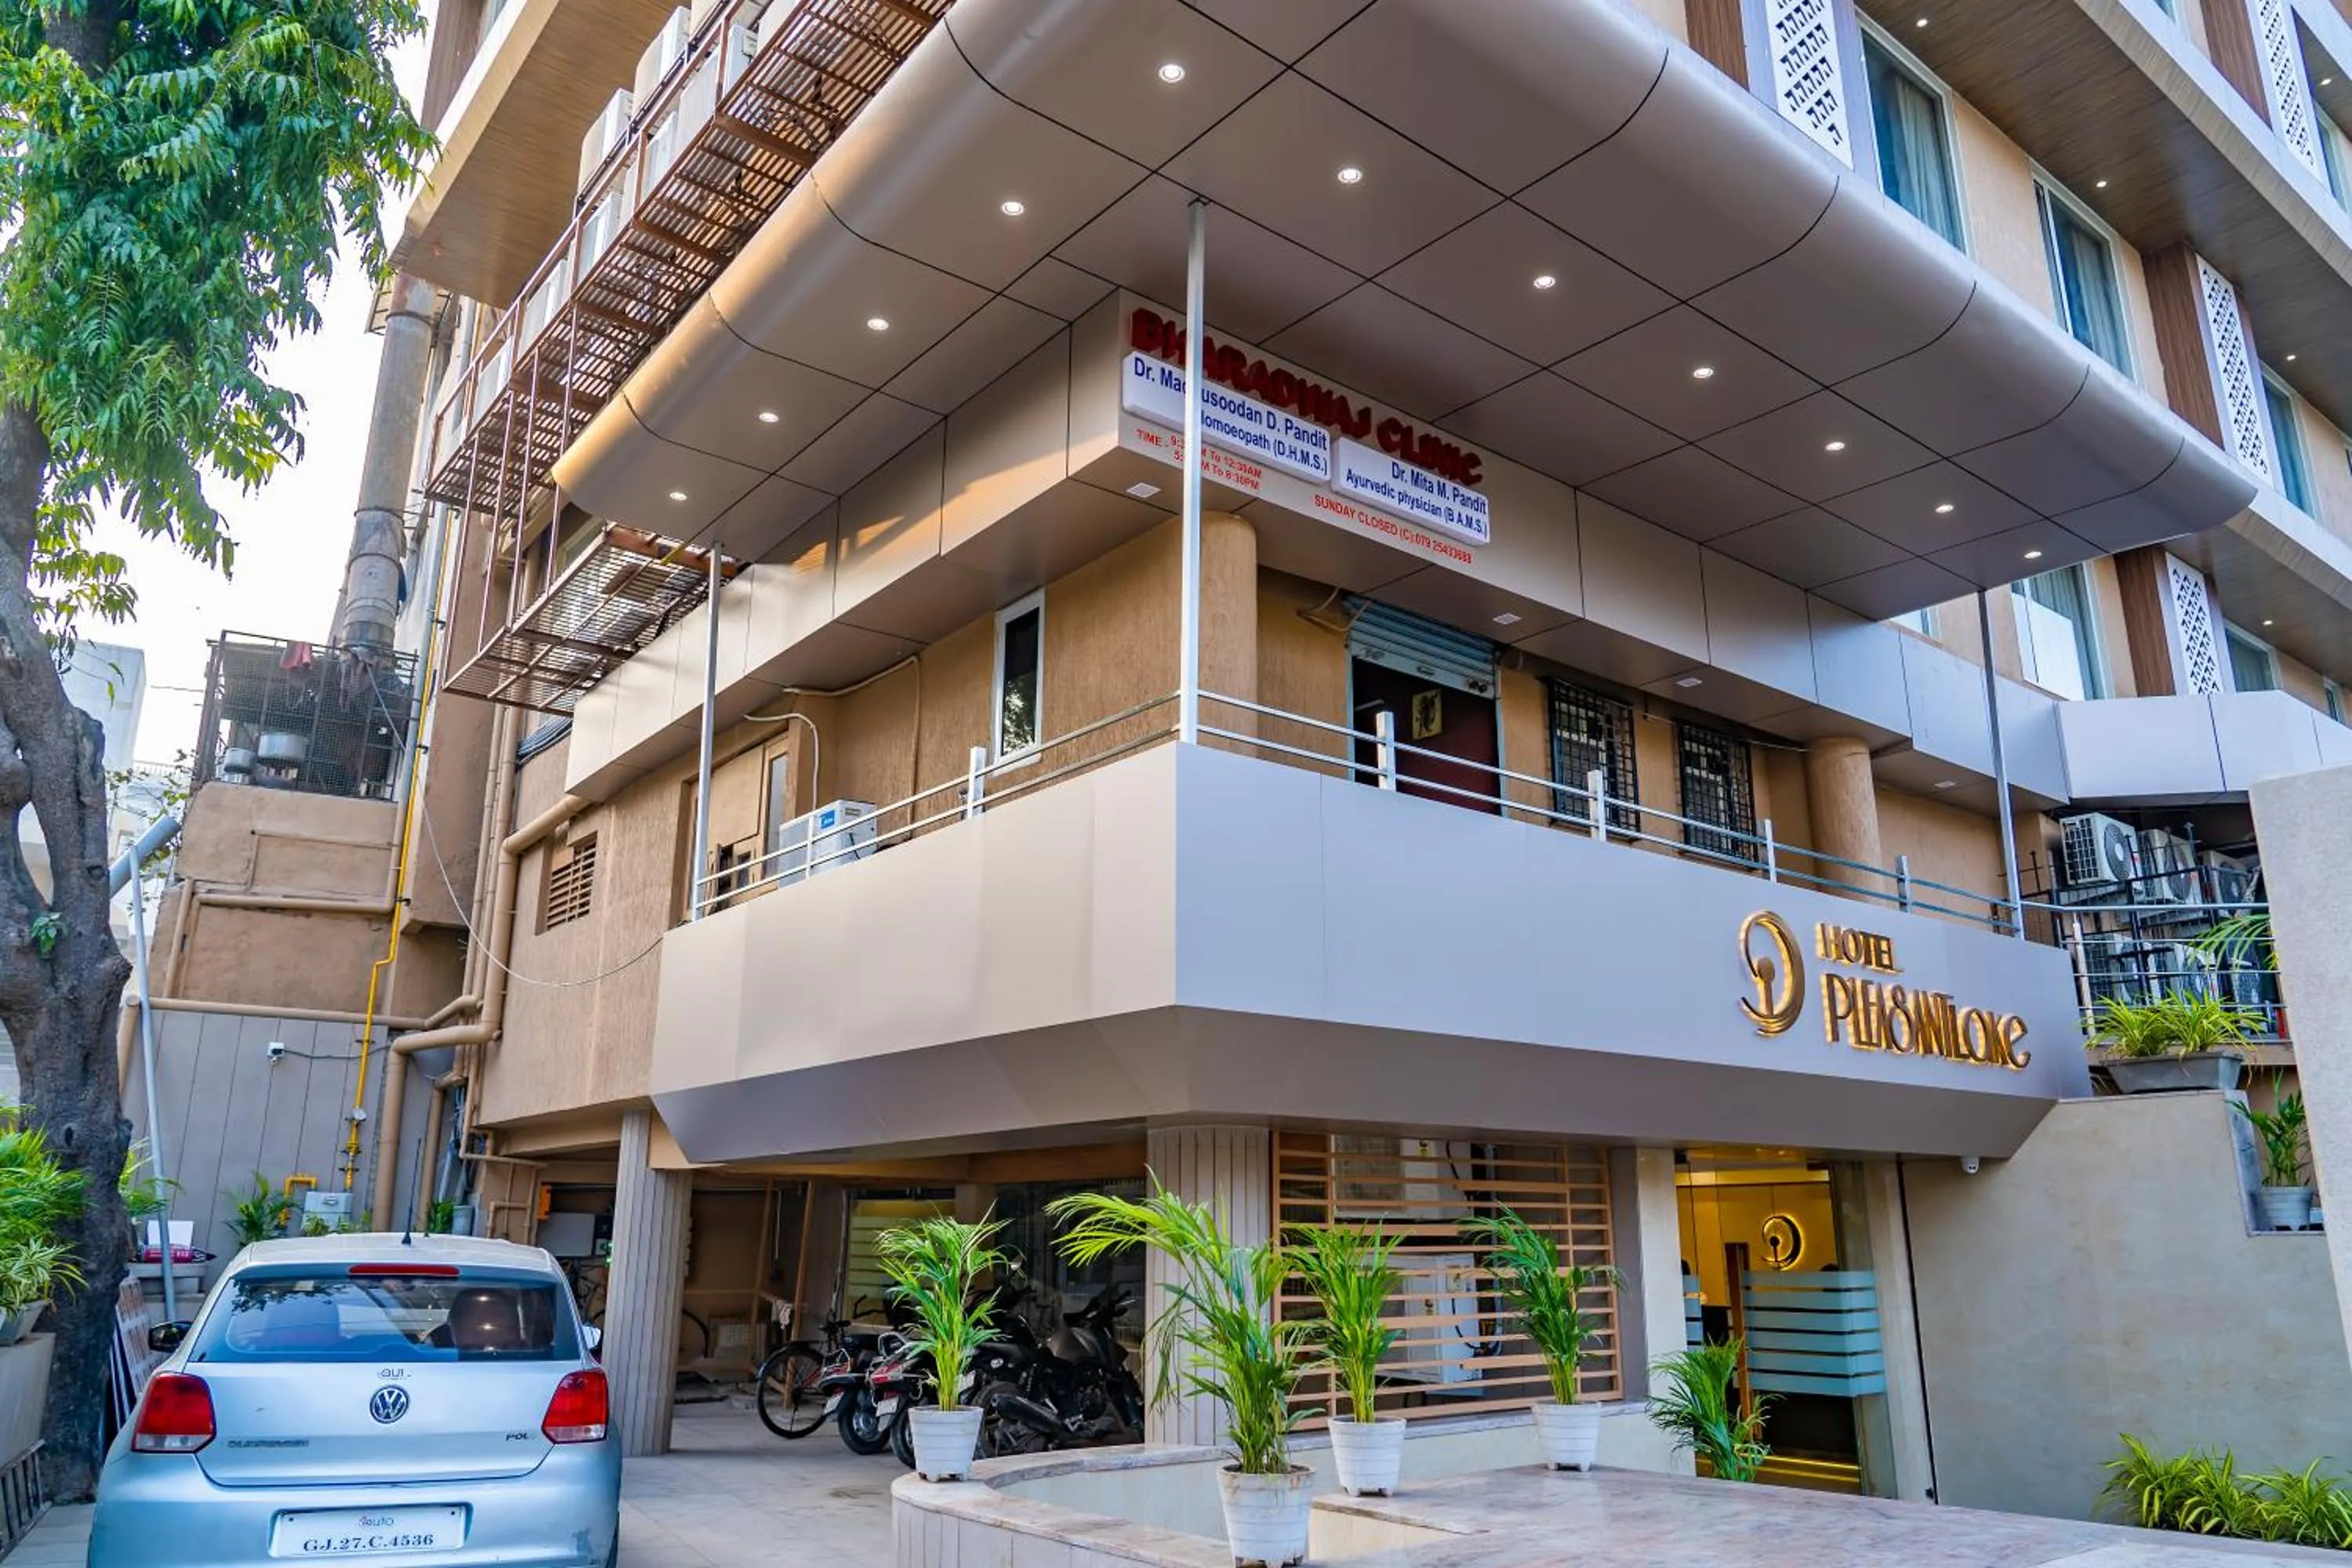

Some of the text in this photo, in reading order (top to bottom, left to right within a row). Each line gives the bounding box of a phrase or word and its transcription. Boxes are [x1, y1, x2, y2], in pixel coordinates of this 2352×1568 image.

[1134, 357, 1327, 451] Dr. Mausoodan D. Pandit
[1135, 428, 1161, 447] TIME
[1377, 417, 1483, 486] CLINIC
[1346, 468, 1396, 499] Ayurvedic
[1398, 488, 1443, 517] physician
[1392, 462, 1487, 514] Dr. Mita M. Pandit
[1315, 495, 1356, 519] SUNDAY
[1358, 511, 1398, 536] CLOSED
[1815, 922, 1902, 974] HOTEL
